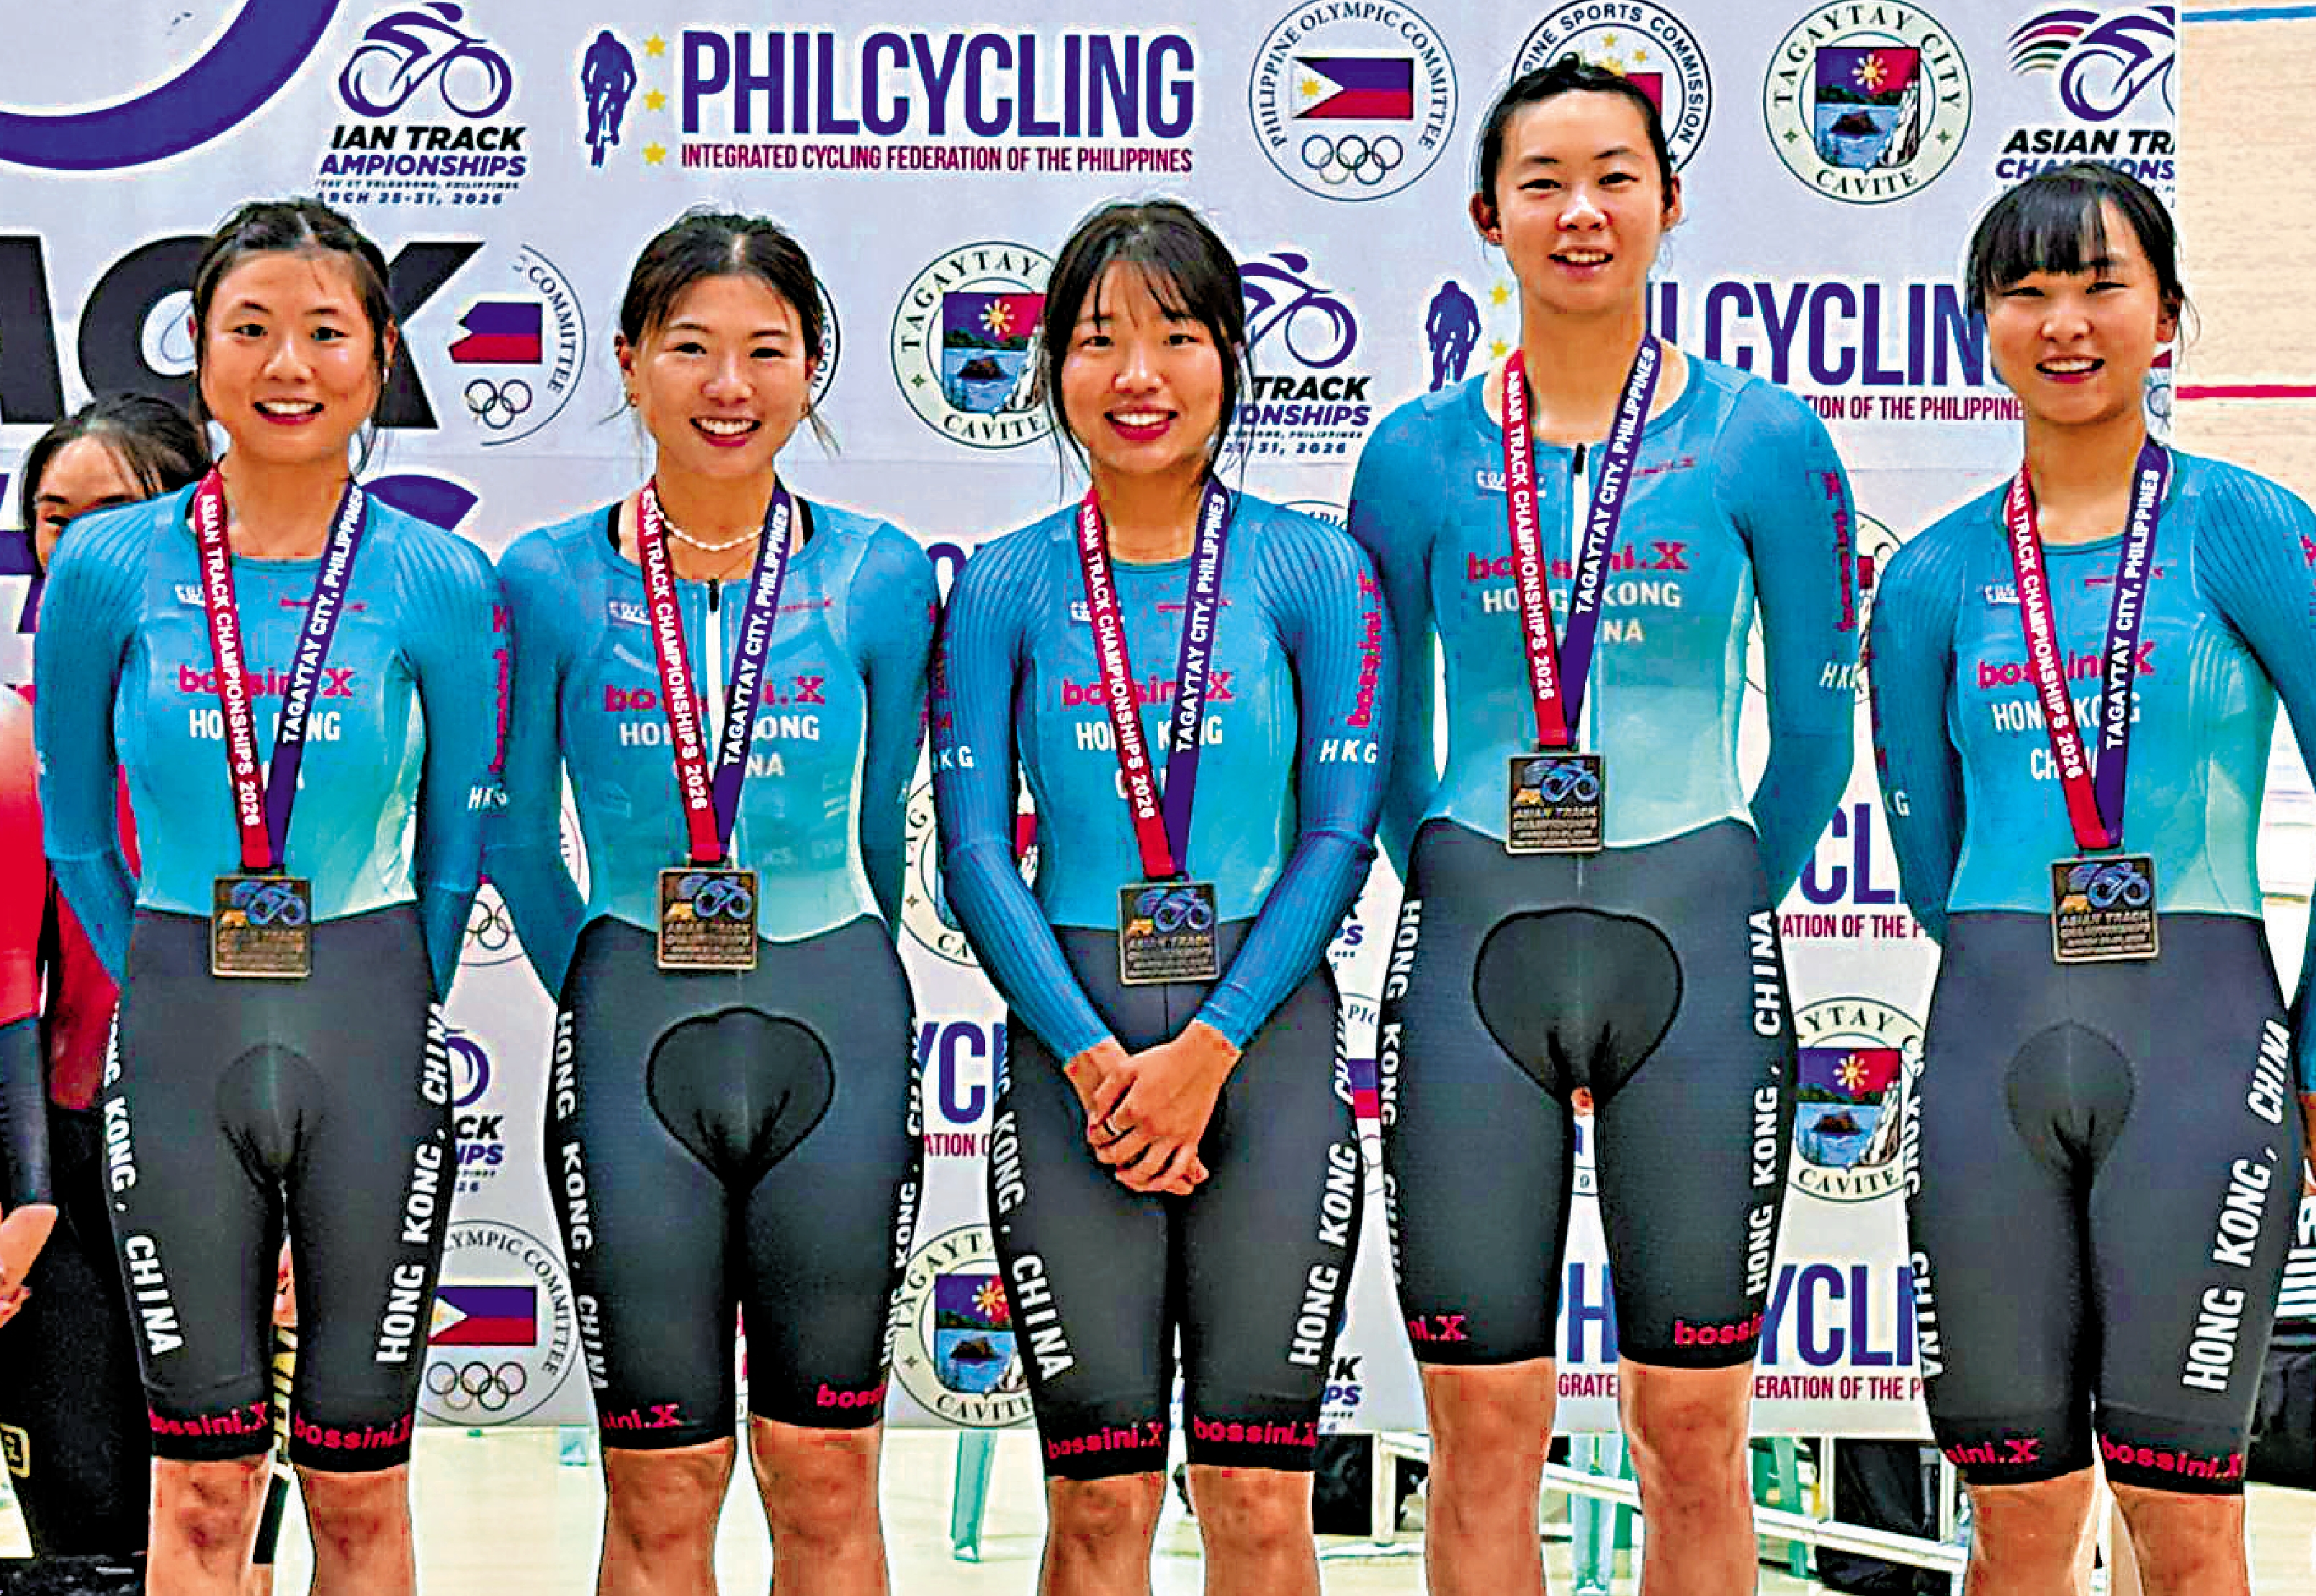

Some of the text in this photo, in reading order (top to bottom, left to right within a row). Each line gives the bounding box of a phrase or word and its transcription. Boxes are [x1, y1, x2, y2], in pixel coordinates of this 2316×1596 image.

[681, 30, 1193, 138] PHILCYCLING
[1259, 1, 1448, 150] PHILIPPINE OLYMPIC COMMITTEE
[1560, 4, 1643, 31] SPORTS
[1649, 17, 1704, 145] COMMISSION
[1774, 5, 1962, 108] TAGAYTAY CITY
[406, 125, 527, 151] TRACK
[681, 144, 1193, 173] INTEGRATED CYCLING FEDERATION OF THE PHILIPPINES
[2002, 129, 2176, 155] ASIAN TR
[1815, 168, 1918, 195] CAVITE
[529, 266, 575, 394] COMMITTEE
[902, 249, 1040, 353] TAGAYTAY
[943, 413, 1045, 441] CAVITE
[1252, 375, 1372, 402] TRACK
[1849, 396, 1872, 420] OF
[1880, 397, 1915, 420] THE
[1509, 424, 1529, 487] TRACK
[1575, 346, 1656, 614] TAGAYTAY CITY, PHILIPPINES
[323, 485, 363, 588] PHILIPPINES
[647, 538, 670, 600] TRACK
[1513, 490, 1548, 651] CHAMPIONSHIPS
[2014, 511, 2037, 574] TRACK
[206, 547, 229, 609] TRACK
[309, 591, 341, 636] CITY,
[1087, 552, 1110, 612] TRACK
[1482, 581, 1682, 614] HOG KONG
[2106, 469, 2160, 750] TAGAYTAY CITY, PHILIPPINES
[723, 503, 789, 766] TAGAYTAY CITY, PHILIPPINES
[1175, 493, 1226, 754] TAGAYTAY CITY, PHILIPPINES
[2022, 575, 2070, 730] CHAMPIONSHIPS
[215, 612, 253, 776] CHAMPIONSHIPS
[282, 638, 322, 744] TAGAYTAY
[655, 603, 700, 761] CHAMPIONSHIPS
[1098, 614, 1144, 771] CHAMPIONSHIPS
[1533, 655, 1556, 701] 2026
[1991, 699, 2046, 731] HON
[751, 714, 820, 741] ONG
[932, 745, 974, 771] KG
[1319, 739, 1379, 764] HKG
[2057, 732, 2083, 779] 2026
[238, 781, 261, 826] 2026
[685, 763, 708, 810] 2026
[1131, 774, 1155, 818] 2026
[1385, 900, 1422, 1002] HONG
[1841, 914, 1865, 938] OF
[1870, 915, 1907, 938] THE
[1746, 910, 1783, 1296] HONG KONG, CHINA
[555, 1010, 575, 1121] HONG
[577, 1294, 609, 1389] CHINA
[1797, 1166, 1900, 1196] CAVITE
[2182, 1018, 2291, 1392] HONG KONG, CHINA
[375, 1263, 426, 1365] HONG
[401, 1128, 447, 1248] KONG,
[124, 1232, 184, 1356] CHINA
[524, 1250, 571, 1377] COMMITTEE
[1013, 1255, 1074, 1381] CHINA
[1288, 1263, 1341, 1366] HONG
[1911, 1251, 1944, 1378] CHINA
[1839, 1376, 1862, 1401] OF
[1868, 1376, 1905, 1401] THE
[1048, 1422, 1164, 1460] bossini.X
